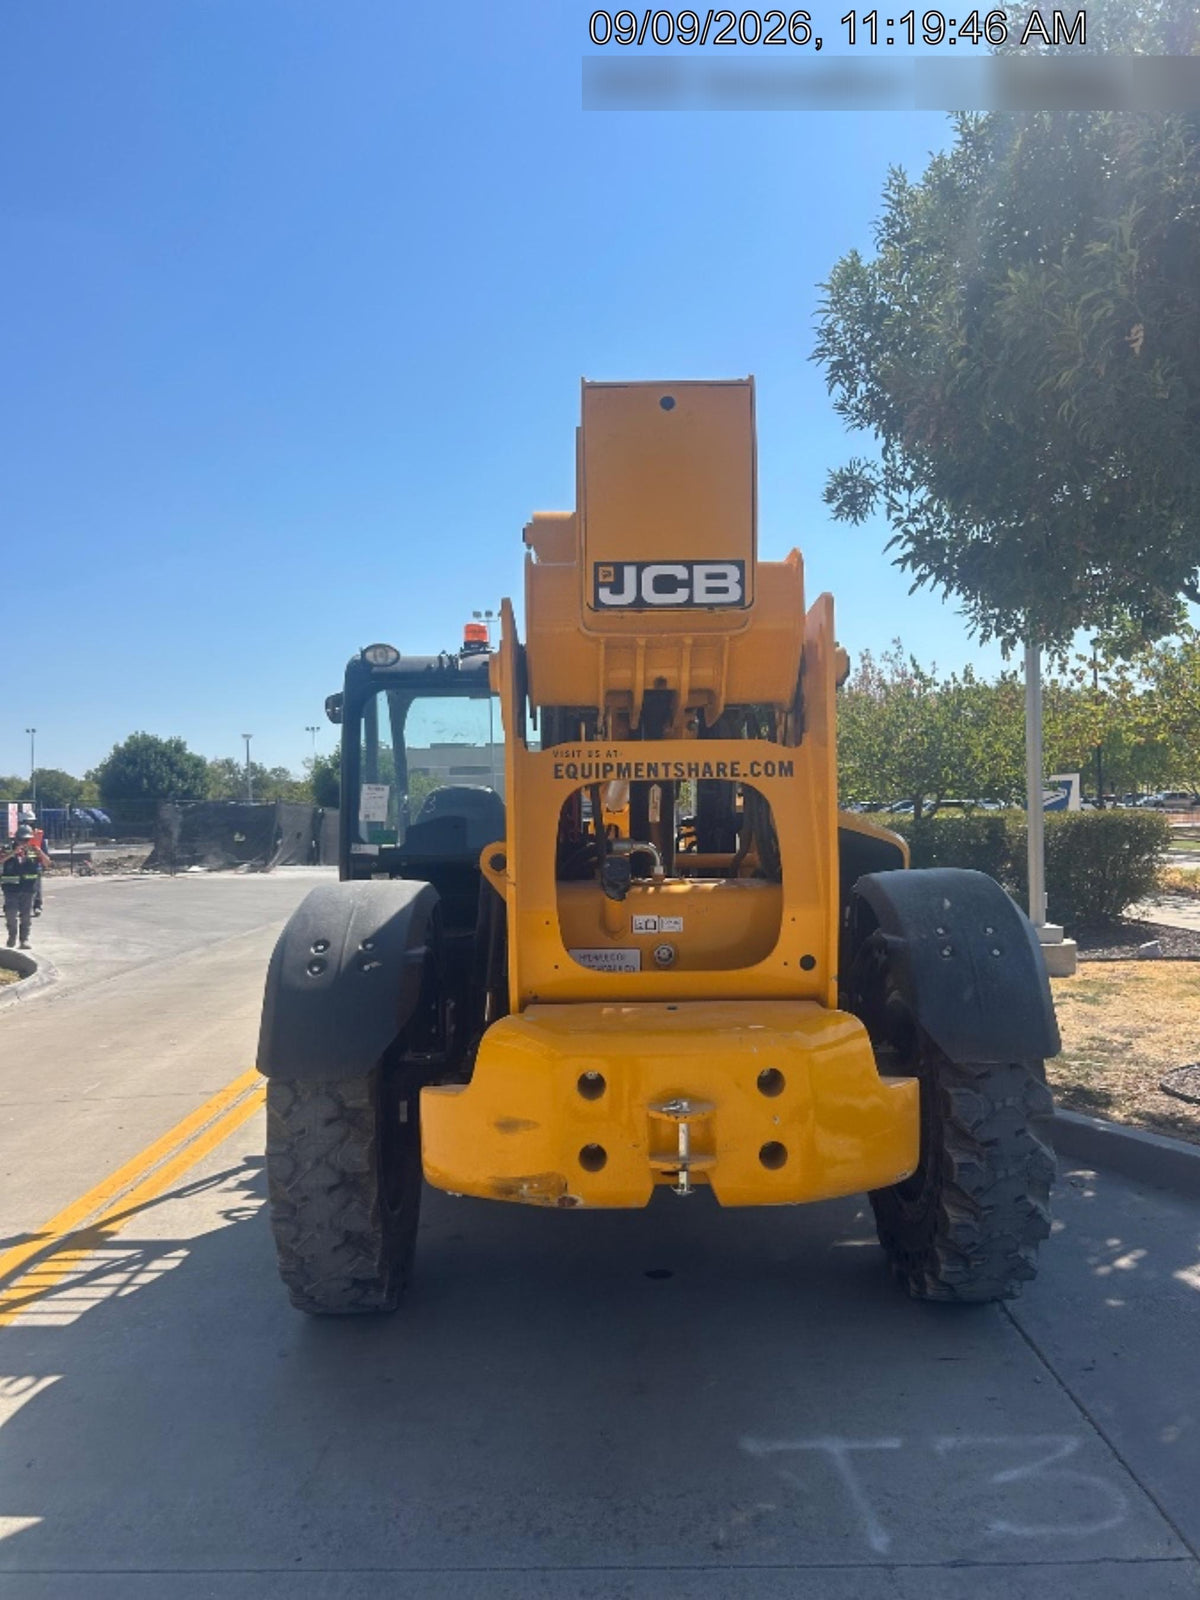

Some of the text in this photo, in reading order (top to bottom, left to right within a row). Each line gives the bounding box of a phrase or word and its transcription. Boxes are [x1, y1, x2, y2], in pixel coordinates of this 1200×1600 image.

[598, 564, 743, 605] JCB
[552, 749, 581, 758] VISIT
[588, 749, 601, 758] US
[553, 760, 794, 780] EQUIPMENTSHARE.COM
